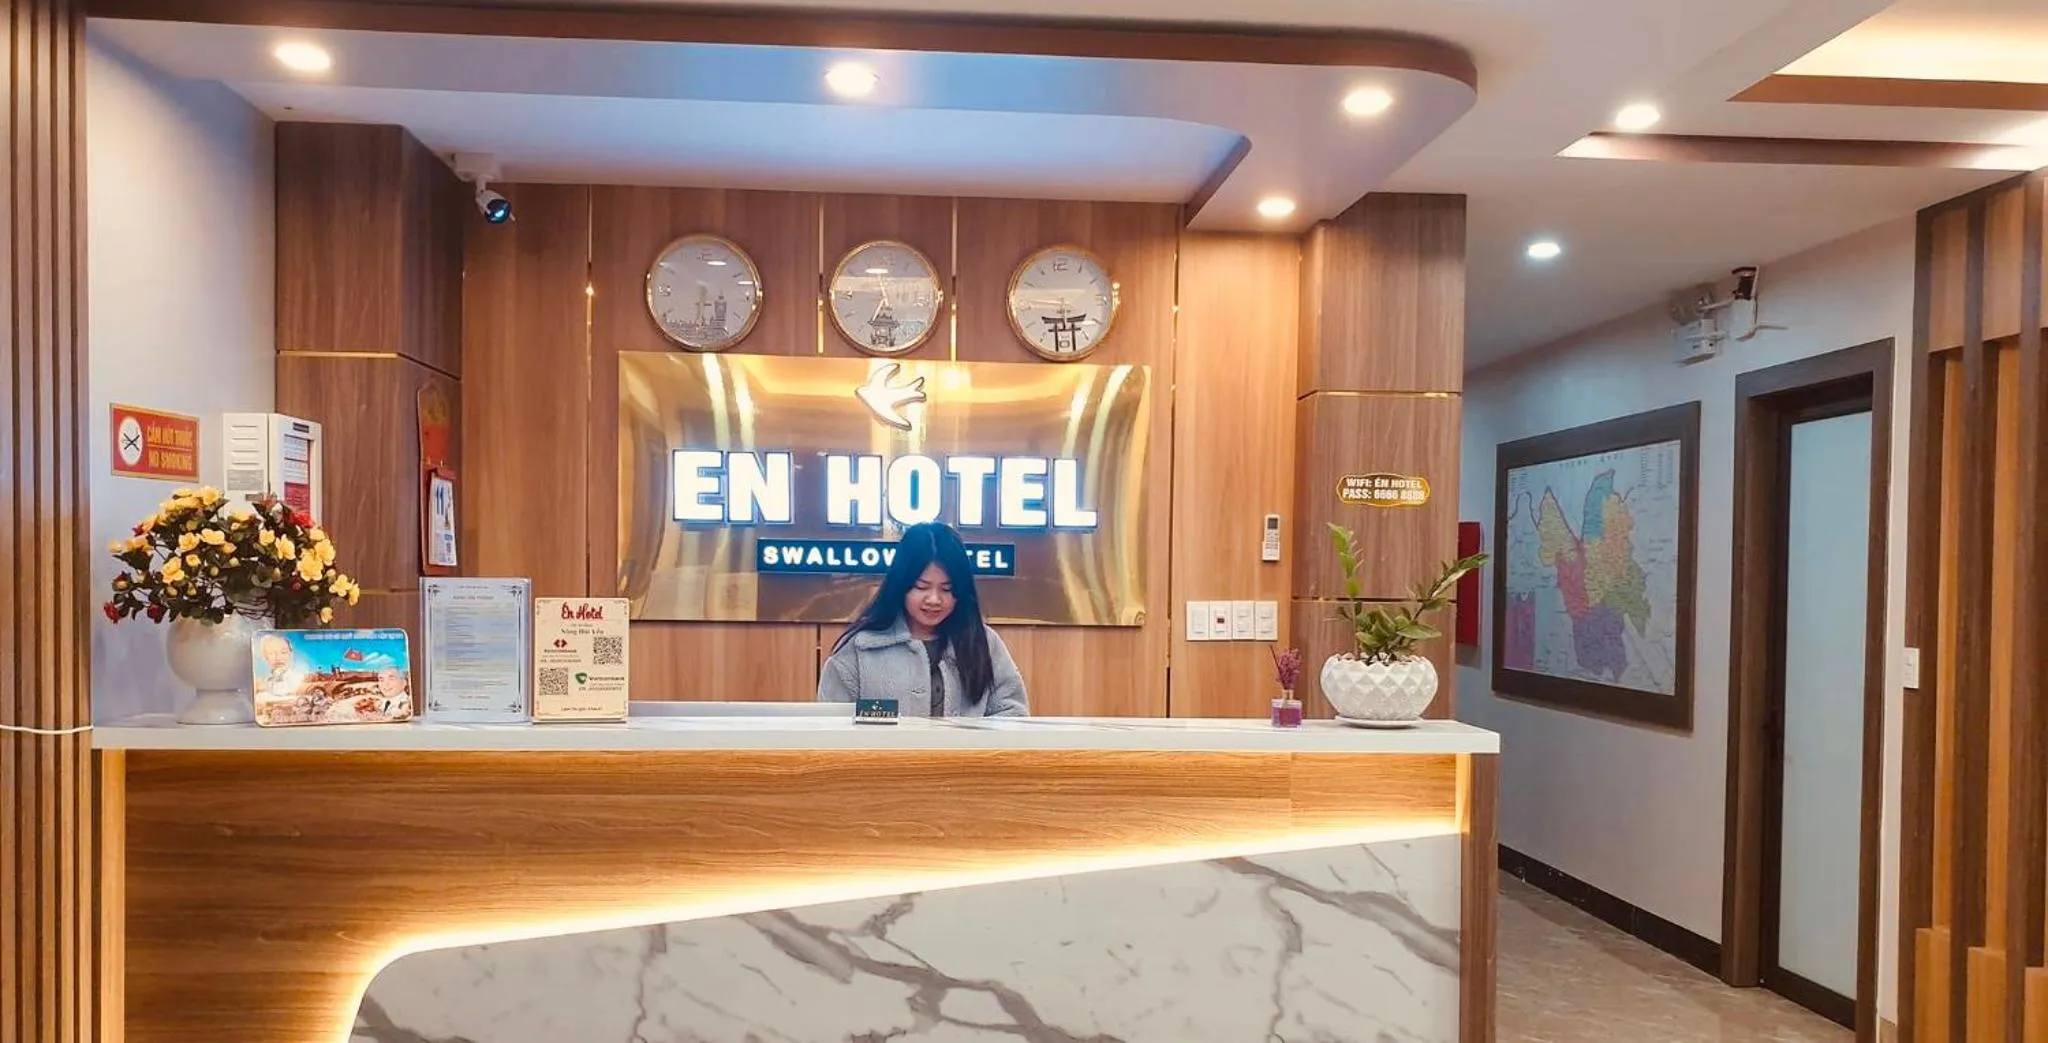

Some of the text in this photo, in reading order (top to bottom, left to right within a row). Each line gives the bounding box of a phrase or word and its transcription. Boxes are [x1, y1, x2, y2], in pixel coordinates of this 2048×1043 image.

[672, 449, 1098, 528] EN HOTEL
[1346, 478, 1373, 488] WIFI:
[1391, 479, 1422, 489] HOTEL
[1342, 488, 1372, 499] PASS:
